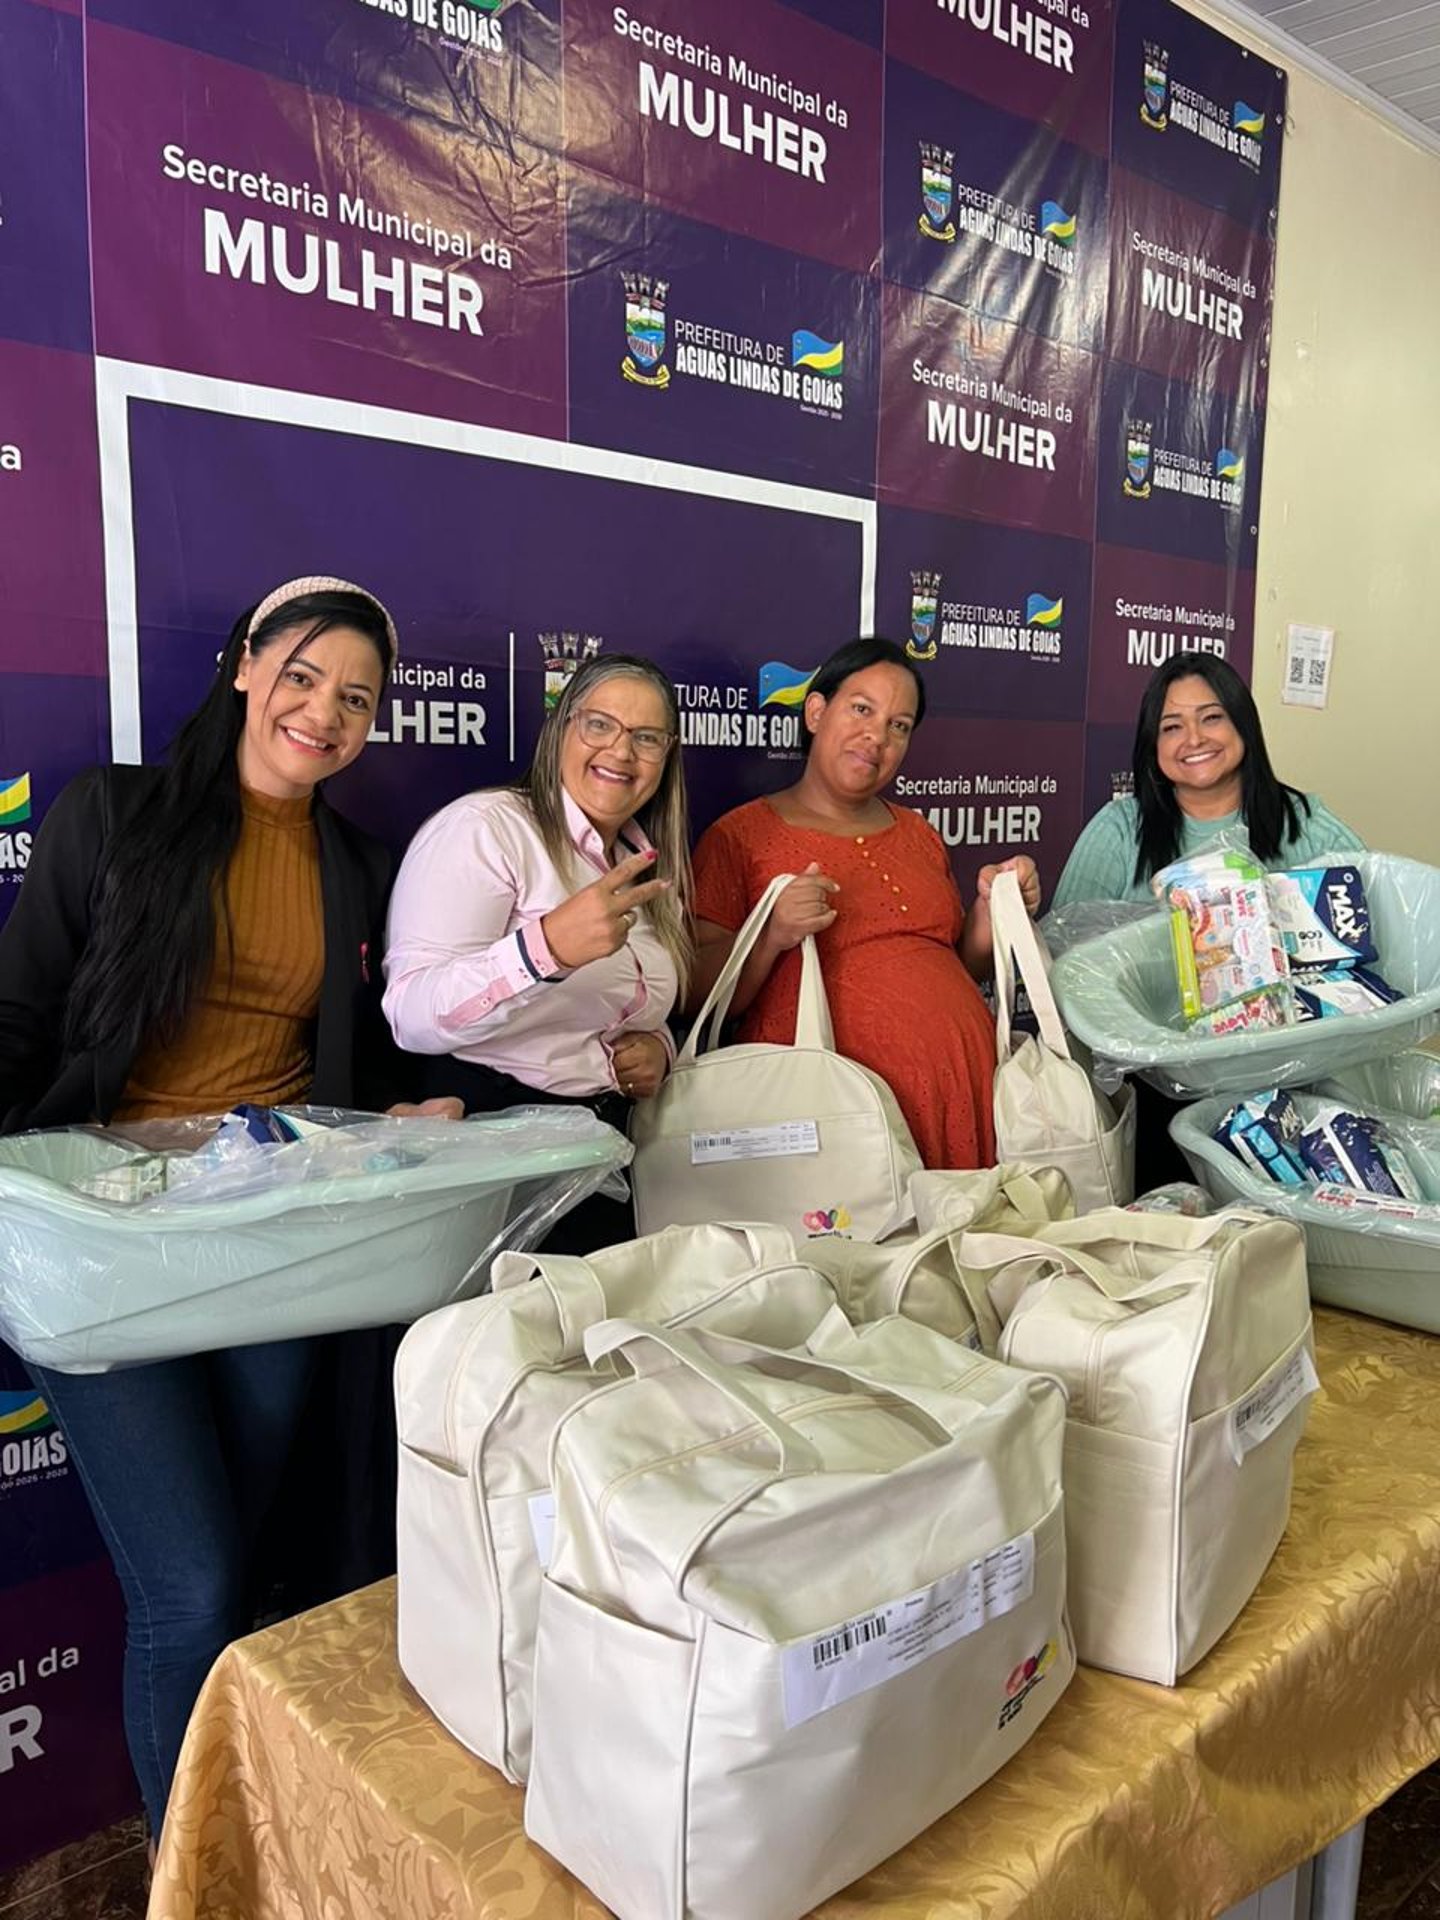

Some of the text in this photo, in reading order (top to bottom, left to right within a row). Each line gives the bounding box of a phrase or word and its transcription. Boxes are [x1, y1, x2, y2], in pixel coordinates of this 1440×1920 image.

[412, 0, 439, 30] DE
[441, 0, 503, 53] GOIÁS
[1070, 4, 1090, 29] da
[613, 6, 849, 130] Secretaria Municipal da
[639, 60, 827, 184] MULHER
[1169, 79, 1231, 128] PREFEITURA DE
[1227, 129, 1240, 155] DE
[162, 143, 512, 271] Secretaria Municipal da
[957, 183, 1037, 232] PREFEITURA DE
[995, 219, 1033, 257] LINDAS
[1033, 234, 1047, 263] DE
[204, 207, 485, 337] MULHER
[1132, 231, 1257, 299] Secretaria Municipal da
[1142, 267, 1244, 340] MULHER
[674, 319, 785, 366] PREFEITURA DE
[675, 342, 844, 410] ÁGUAS LINDAS DE GOIÁS
[912, 358, 1073, 424] Secretaria Municipal da
[0, 444, 22, 471] a
[928, 399, 1057, 472] MULHER
[1153, 447, 1213, 477] PREFEITURA DE
[1210, 477, 1221, 501] DE
[941, 602, 1021, 627] PREFEITURA DE
[1115, 597, 1236, 632] Secretaria Municipal da
[979, 625, 1017, 651] LINDAS
[1018, 628, 1032, 653] DE
[391, 661, 487, 692] icipal da
[726, 686, 749, 710] DE
[365, 699, 488, 746] LHER
[679, 711, 799, 748] LINDAS DE GOI
[895, 774, 1058, 799] Secretaria Municipal da
[1327, 884, 1364, 941] MAX
[0, 1430, 68, 1476] OIÁS
[37, 1646, 80, 1678] da
